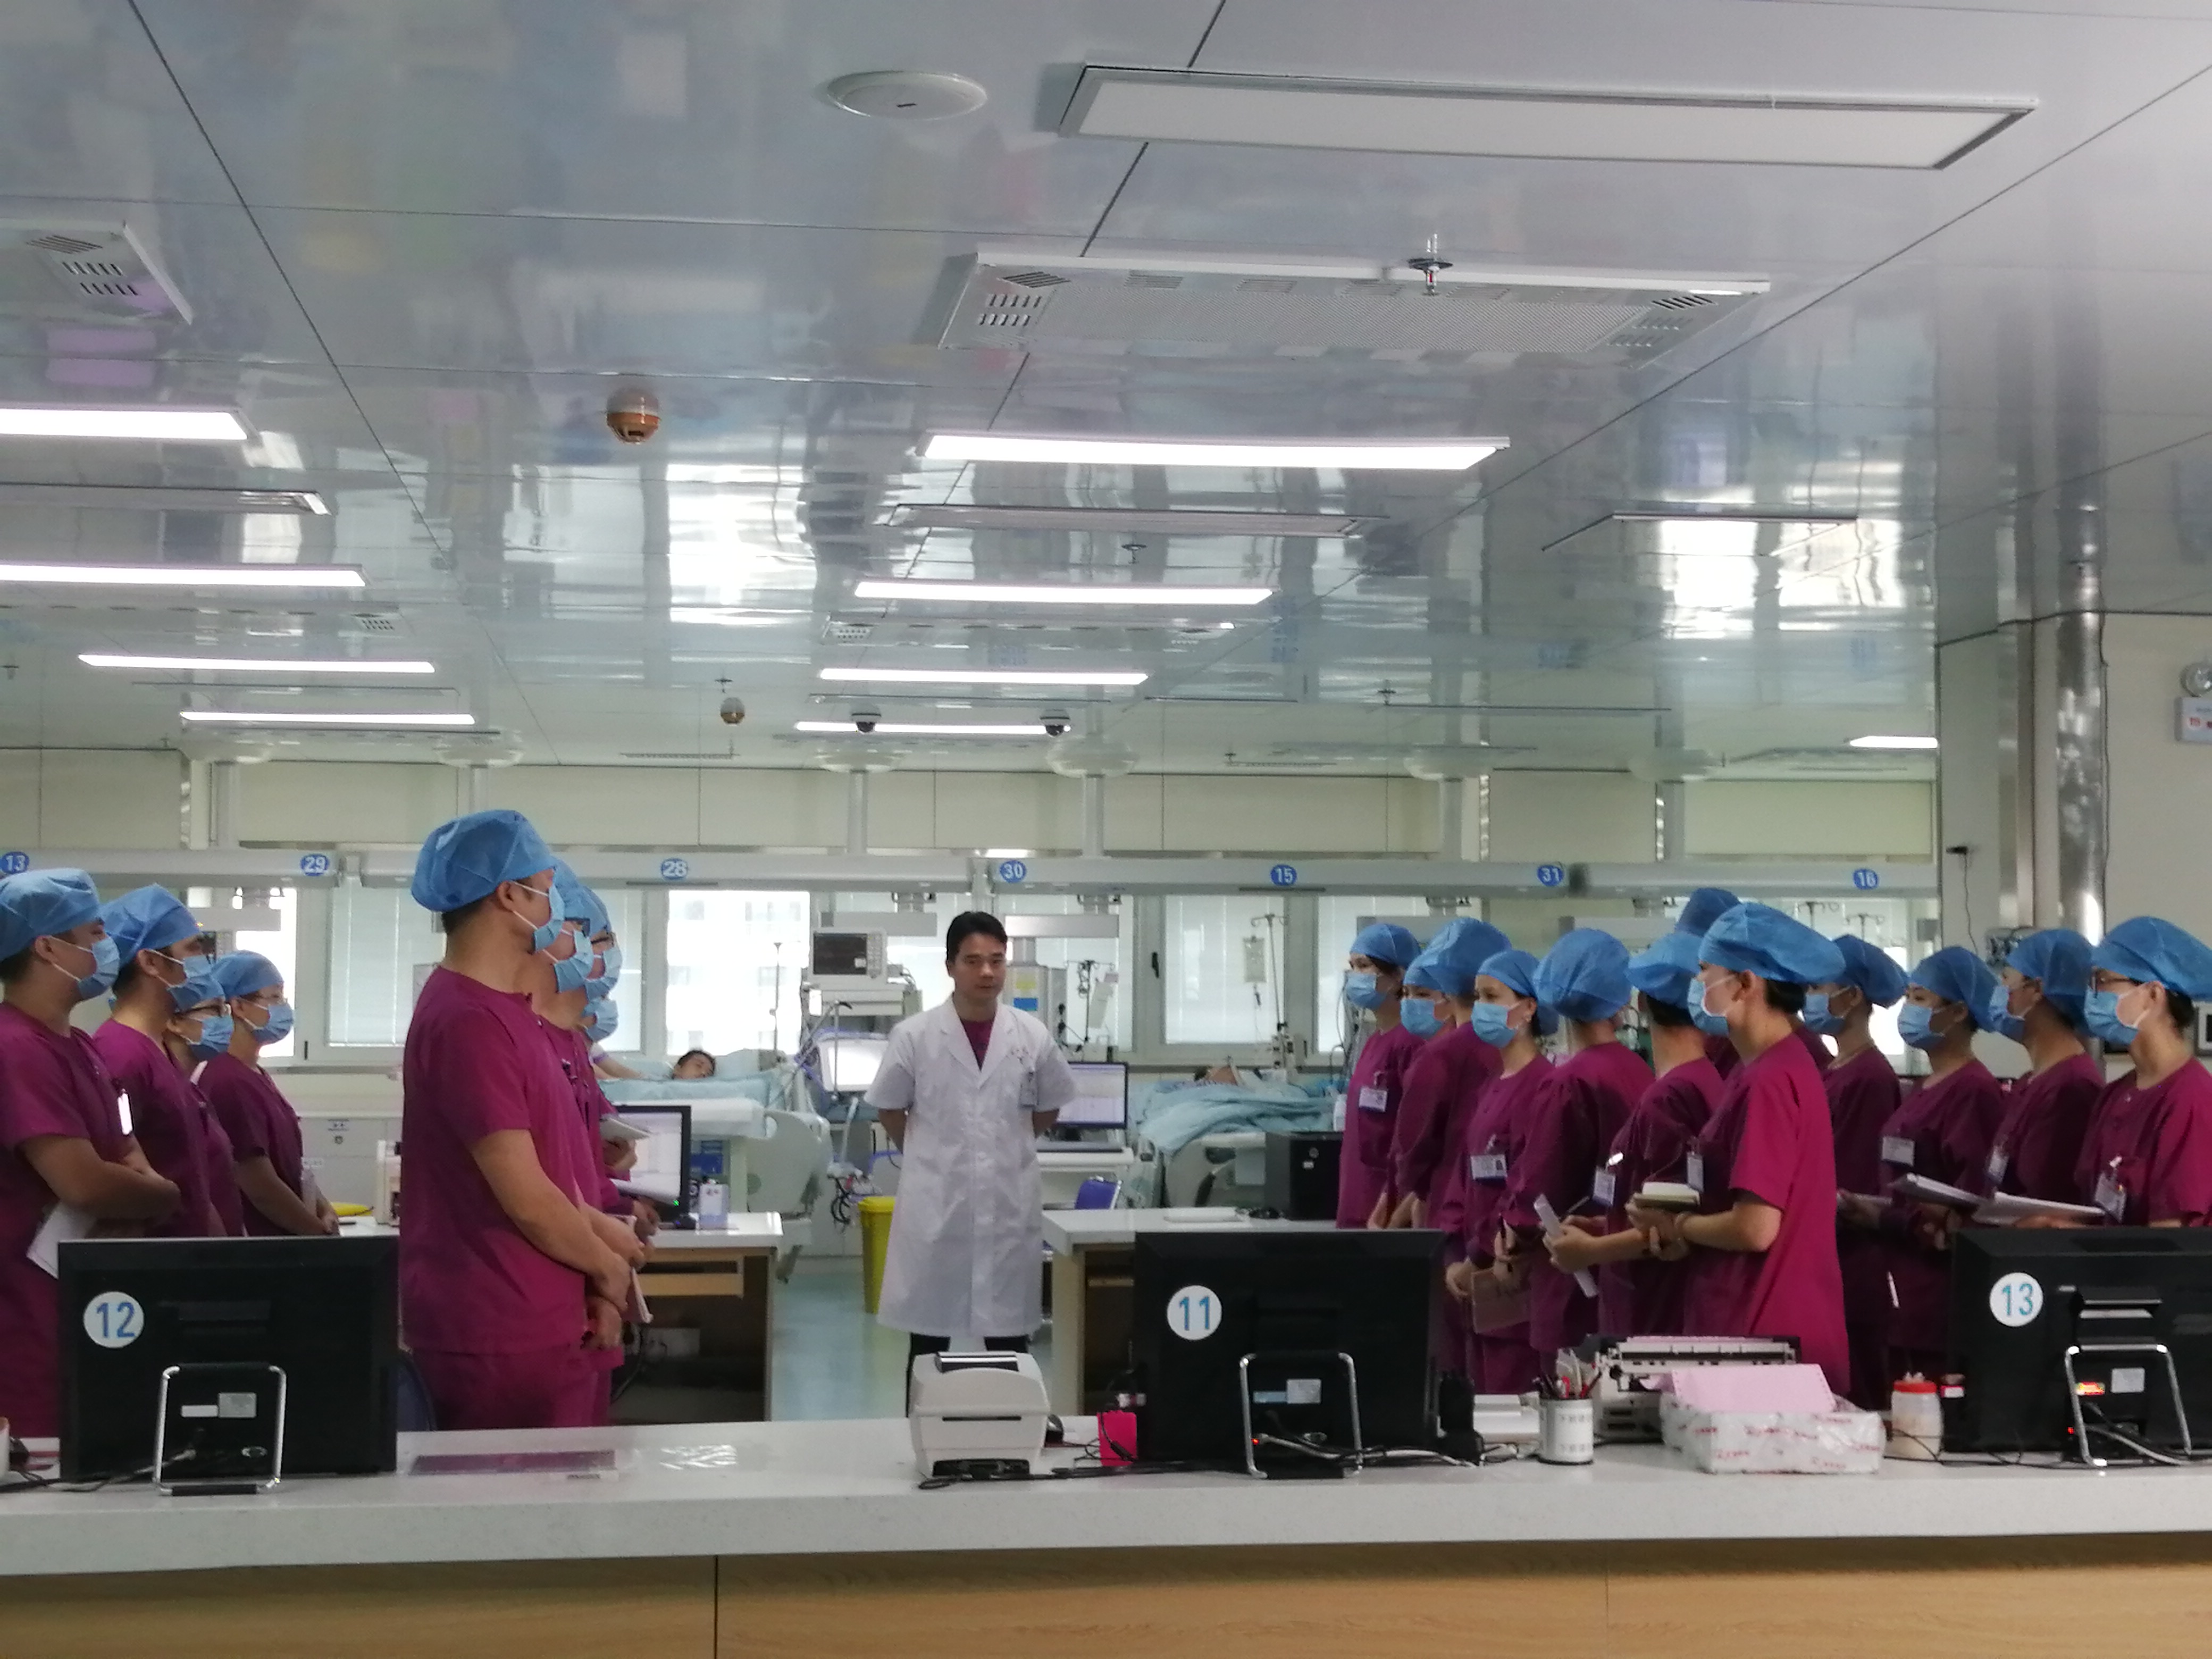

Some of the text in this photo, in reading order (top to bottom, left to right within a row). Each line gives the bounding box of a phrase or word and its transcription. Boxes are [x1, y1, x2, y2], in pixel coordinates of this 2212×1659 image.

[5, 855, 26, 872] 13
[305, 856, 325, 873] 29
[1004, 863, 1023, 879] 30
[1275, 867, 1293, 883] 15
[1541, 867, 1560, 882] 31
[2001, 1283, 2033, 1316] 13
[96, 1302, 135, 1338] 12
[1179, 1296, 1210, 1331] 11
